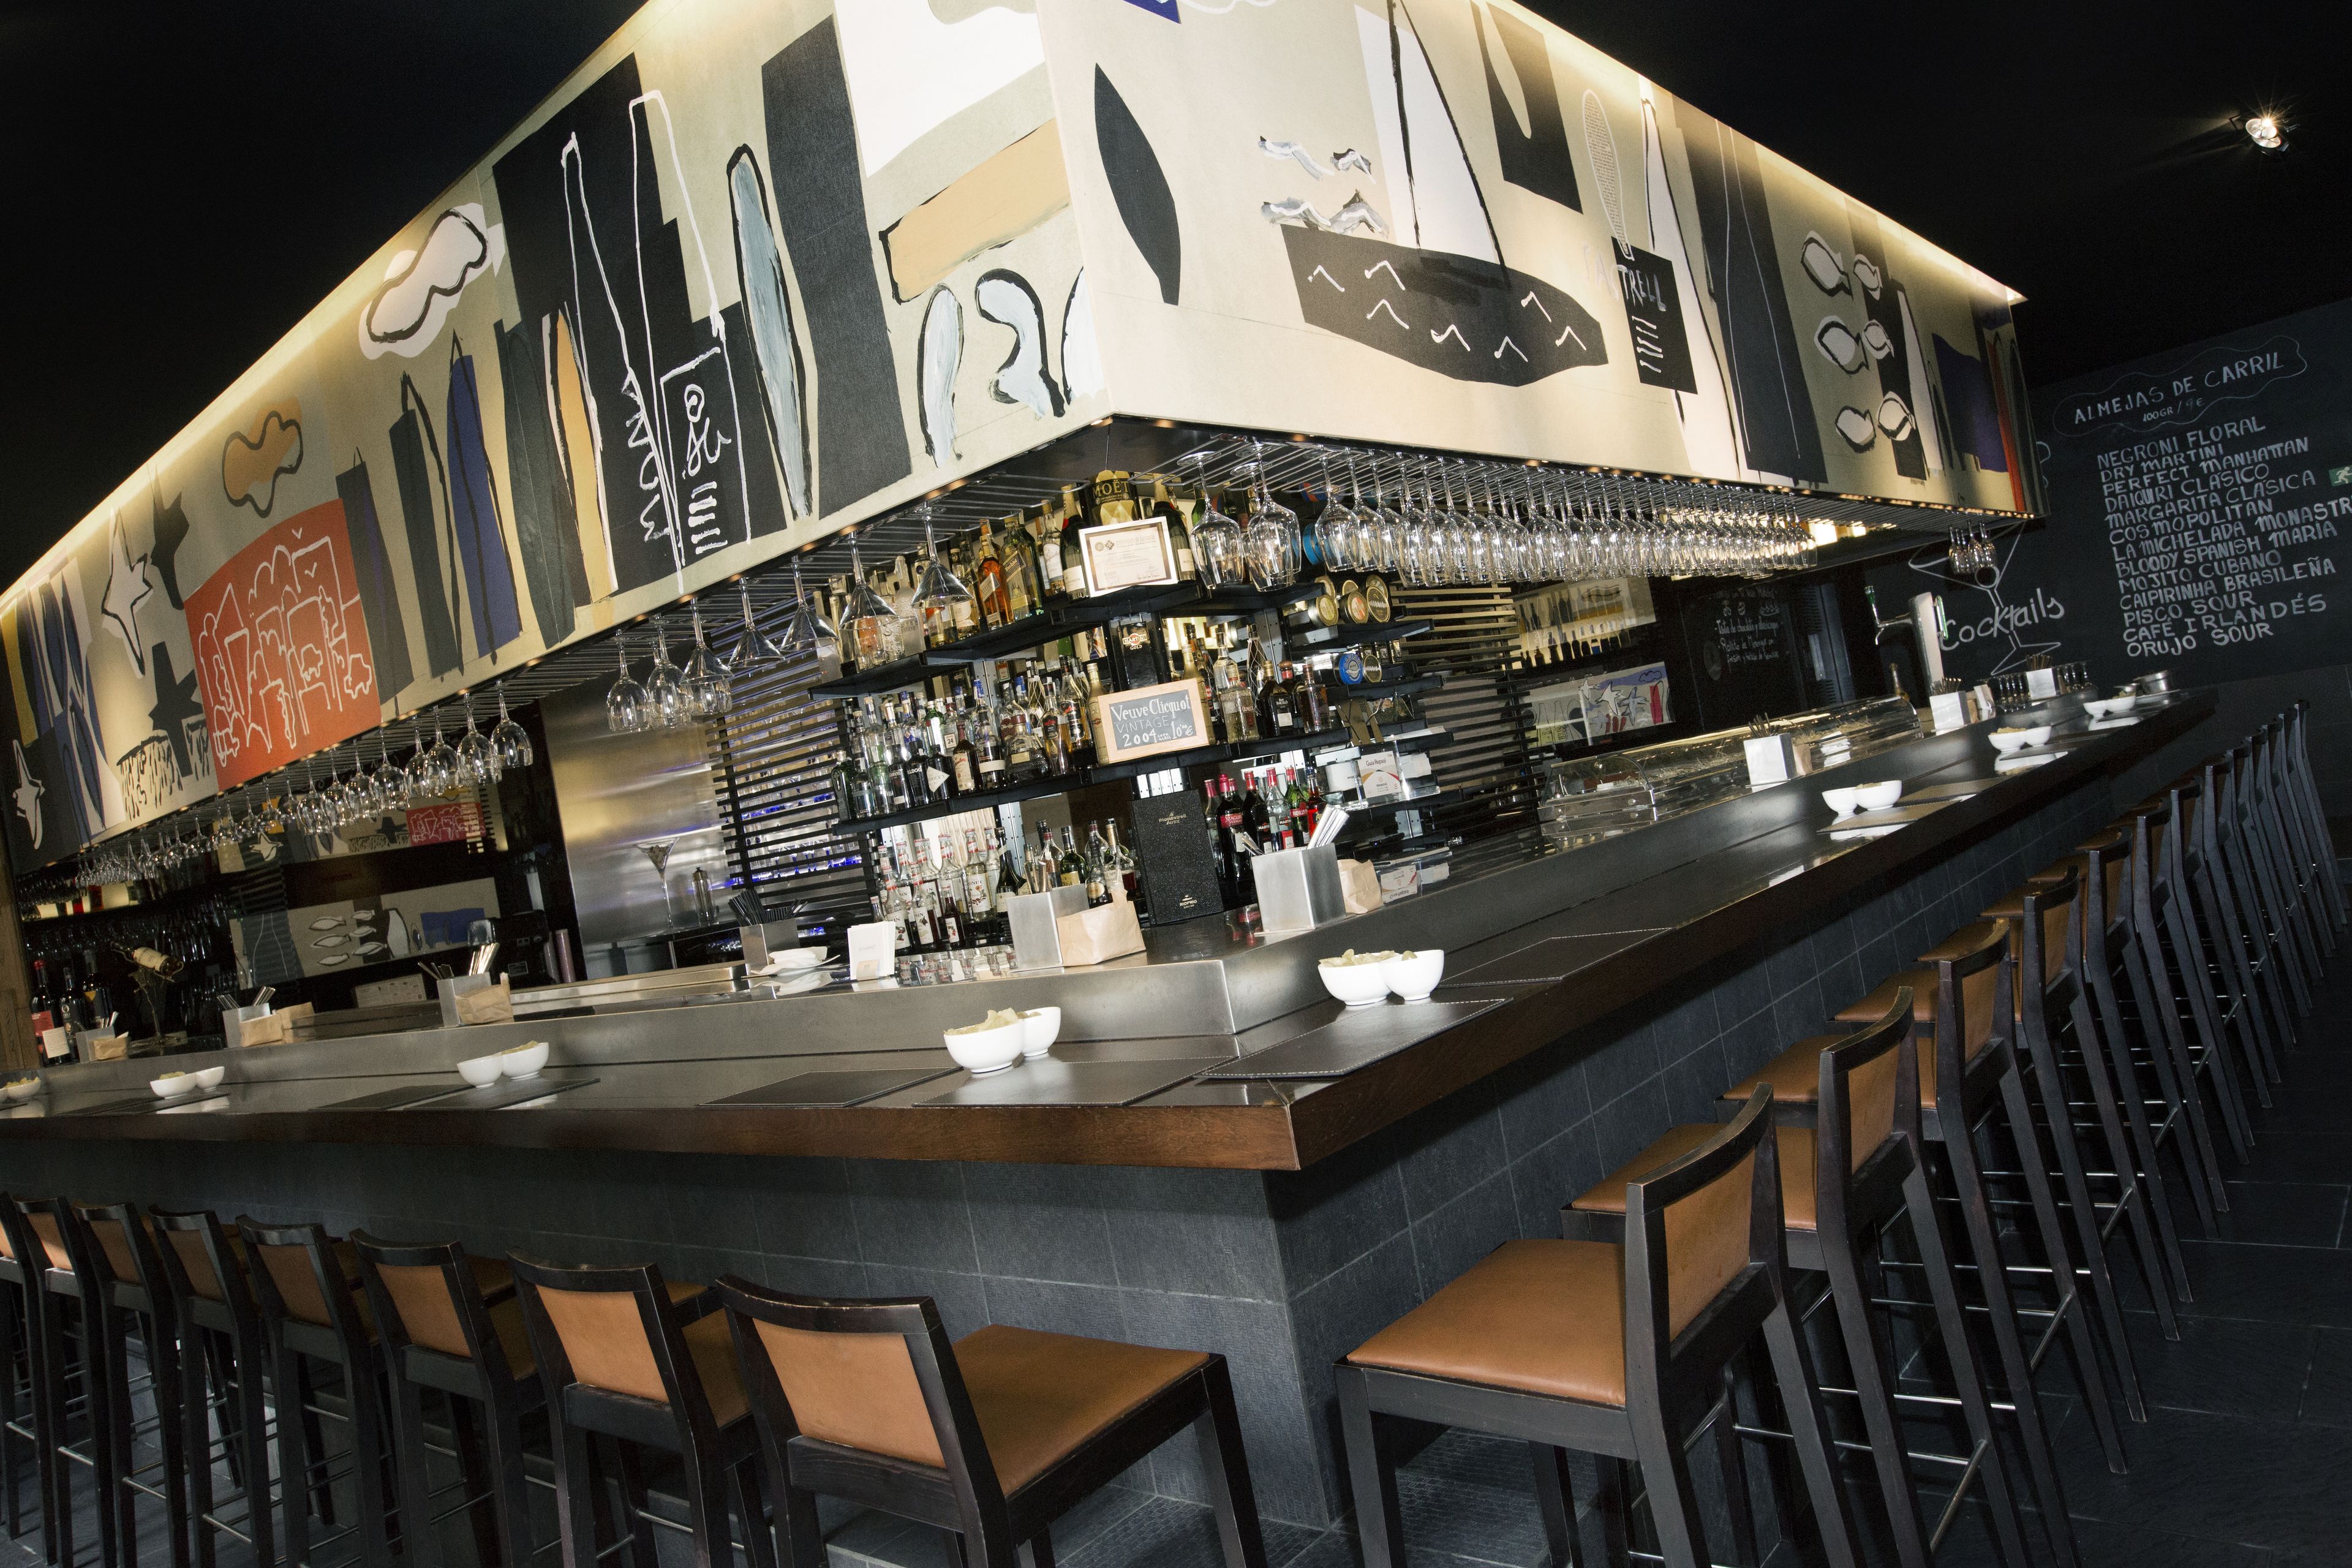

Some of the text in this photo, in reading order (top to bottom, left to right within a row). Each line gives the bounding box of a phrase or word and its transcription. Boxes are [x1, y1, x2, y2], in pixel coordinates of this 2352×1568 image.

[2075, 352, 2284, 424] ALMEJAS DE CARRIL
[2097, 417, 2266, 469] NEGRONI FLORAL
[2101, 443, 2223, 483] DRY MARTINI
[2103, 437, 2309, 496] PERFECT MANHATTAN
[1093, 479, 1128, 497] MOËT
[2105, 463, 2269, 513] DAIQUIRI CLÁSICO
[2105, 470, 2316, 529] MARGARITA CLÁSICA
[2109, 498, 2273, 545] COSMOPOLITAN
[2113, 496, 2352, 562] LA MICHELADA MONASTR
[2116, 520, 2337, 578] BLOODY SPANISH MARÍA
[2119, 549, 2282, 594] MOJITO CUBANO
[2120, 556, 2336, 610] CAIPIRINHA BRASILEÑA
[1939, 587, 2065, 651] Cocktails
[2123, 592, 2327, 643] CAFÉ IRLANDÉS
[2124, 590, 2256, 627] PISCO SOUR
[1123, 634, 1147, 645] MARTINI
[2127, 622, 2274, 657] ORUJO SOUR
[1110, 694, 1191, 721] Veuve Clicquot
[1116, 715, 1170, 734] VINTAGE
[1122, 728, 1158, 747] 2004
